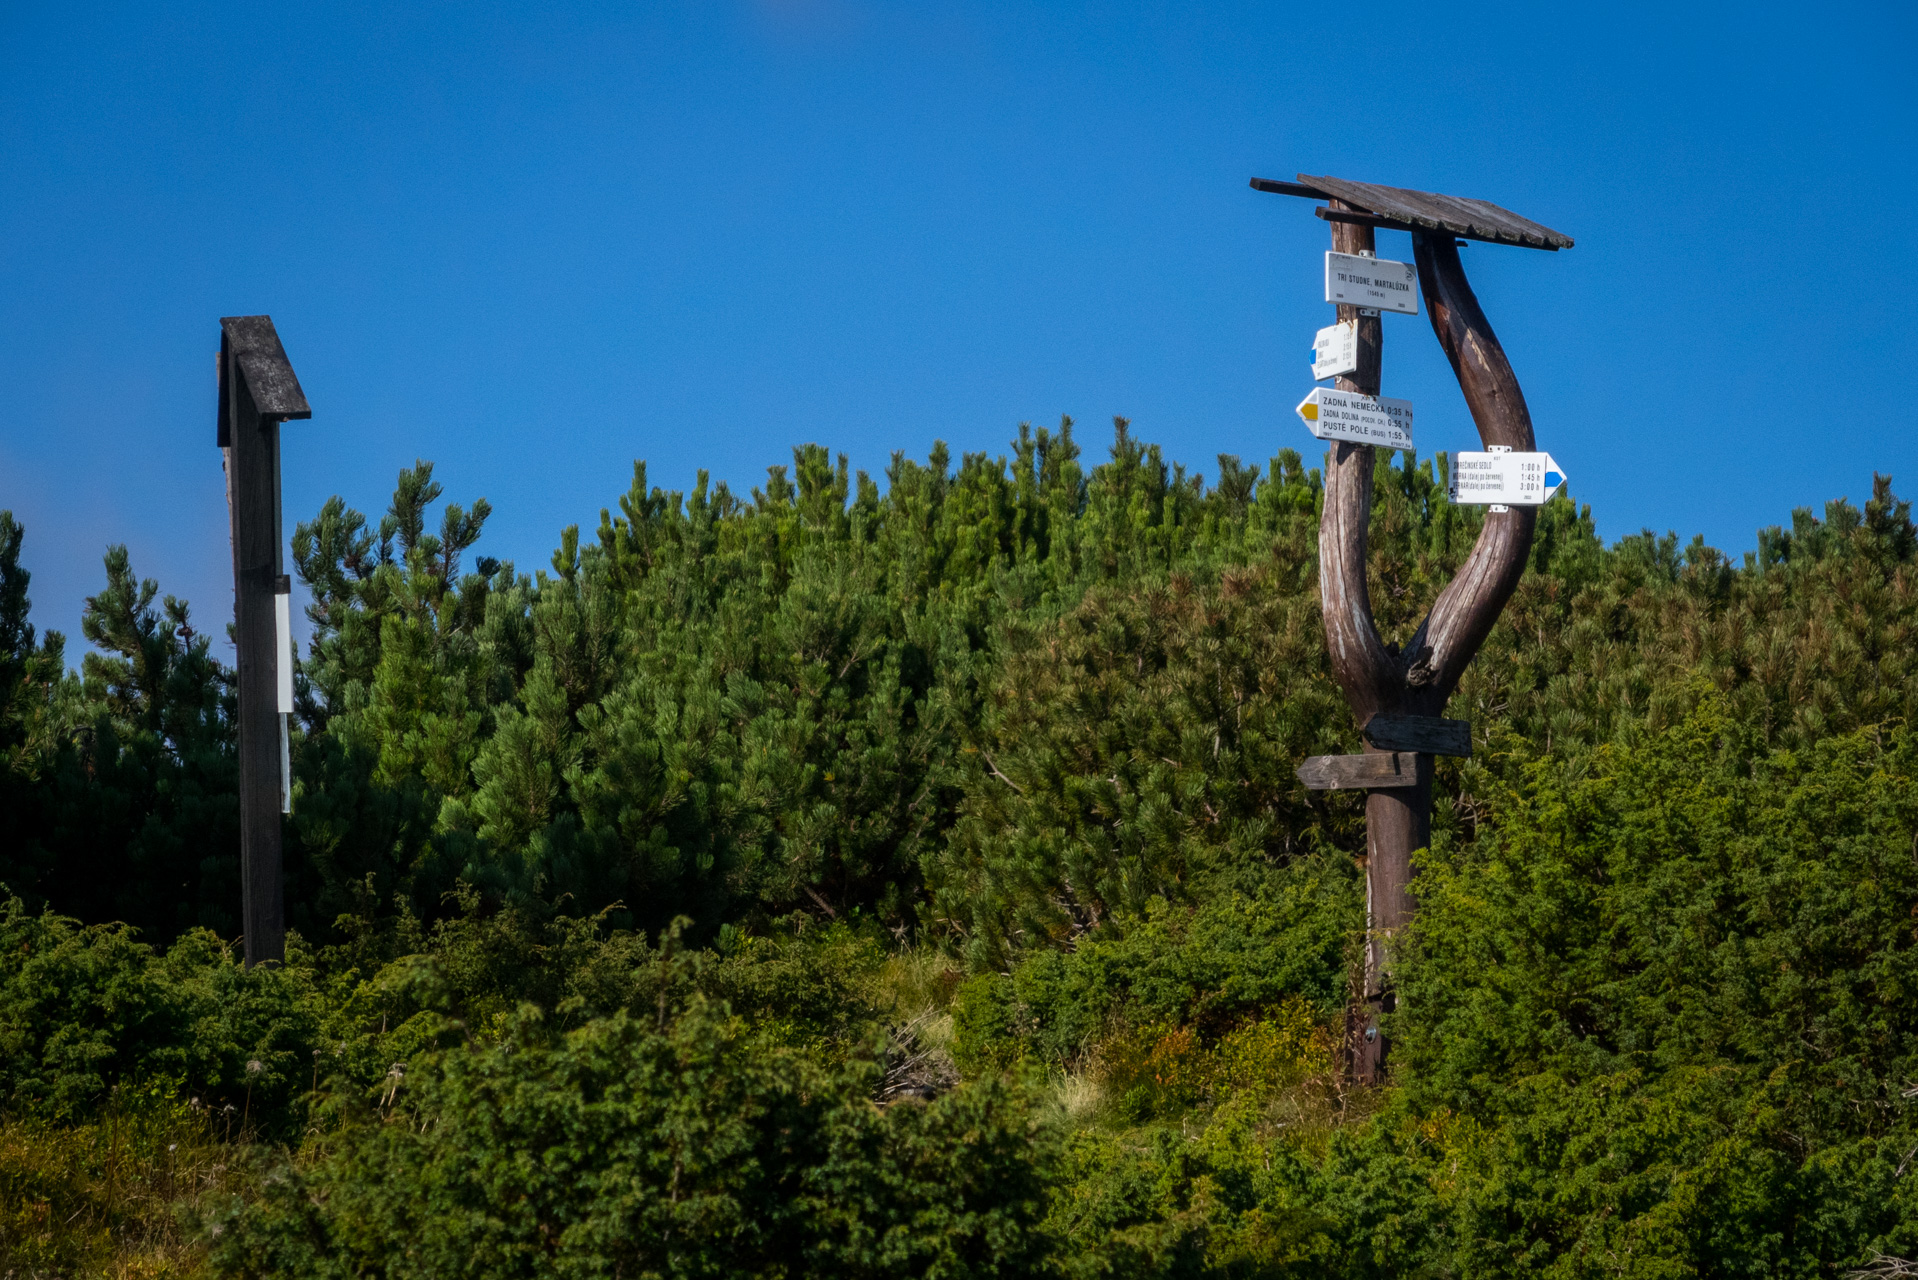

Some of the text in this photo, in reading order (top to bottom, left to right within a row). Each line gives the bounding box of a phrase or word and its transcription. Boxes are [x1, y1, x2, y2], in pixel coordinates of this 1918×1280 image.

[1337, 272, 1347, 282] TRI
[1374, 278, 1410, 292] MARTALÚZKA
[1323, 396, 1410, 417] ZADNÁ NEMECKÁ 0:35 h
[1323, 408, 1340, 418] ZADNÁ
[1341, 411, 1359, 421] DOLINA
[1387, 418, 1402, 428] 0:55
[1405, 421, 1410, 429] h
[1323, 420, 1410, 441] PUSTÉ POLE (BUS) 1:55 h
[1479, 461, 1492, 470] SEDLO
[1521, 463, 1541, 472] 1:00 h
[1521, 473, 1541, 481] 1:45 h
[1520, 482, 1540, 491] 3:00 h
